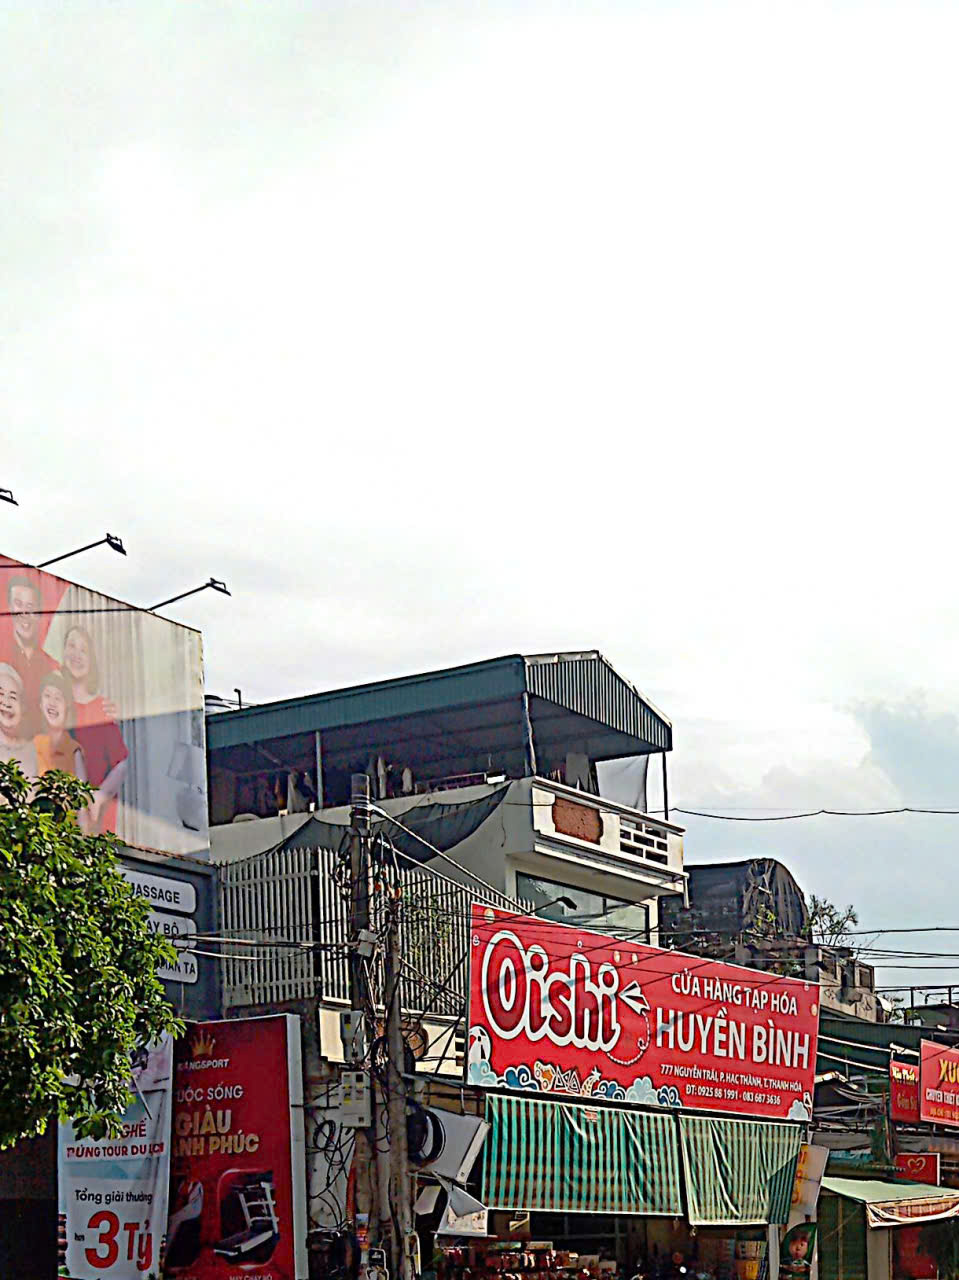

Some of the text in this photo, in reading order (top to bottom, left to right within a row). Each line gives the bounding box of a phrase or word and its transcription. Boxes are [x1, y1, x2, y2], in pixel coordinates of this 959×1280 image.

[482, 930, 621, 1052] Oishi
[671, 968, 798, 1016] CỬA HÀNG TẠP HÓA
[656, 1006, 810, 1069] HUYỀN BÌNH
[660, 1063, 673, 1075] 777
[176, 1081, 244, 1106] UỘC SỐNG
[175, 1103, 232, 1136] GIÀU
[101, 1145, 129, 1157] TOUR
[130, 1144, 147, 1156] DU
[209, 1129, 260, 1155] PHÚC
[74, 1187, 102, 1205] Tổng
[104, 1191, 124, 1205] giải
[84, 1210, 153, 1271] 3 Tỷ
